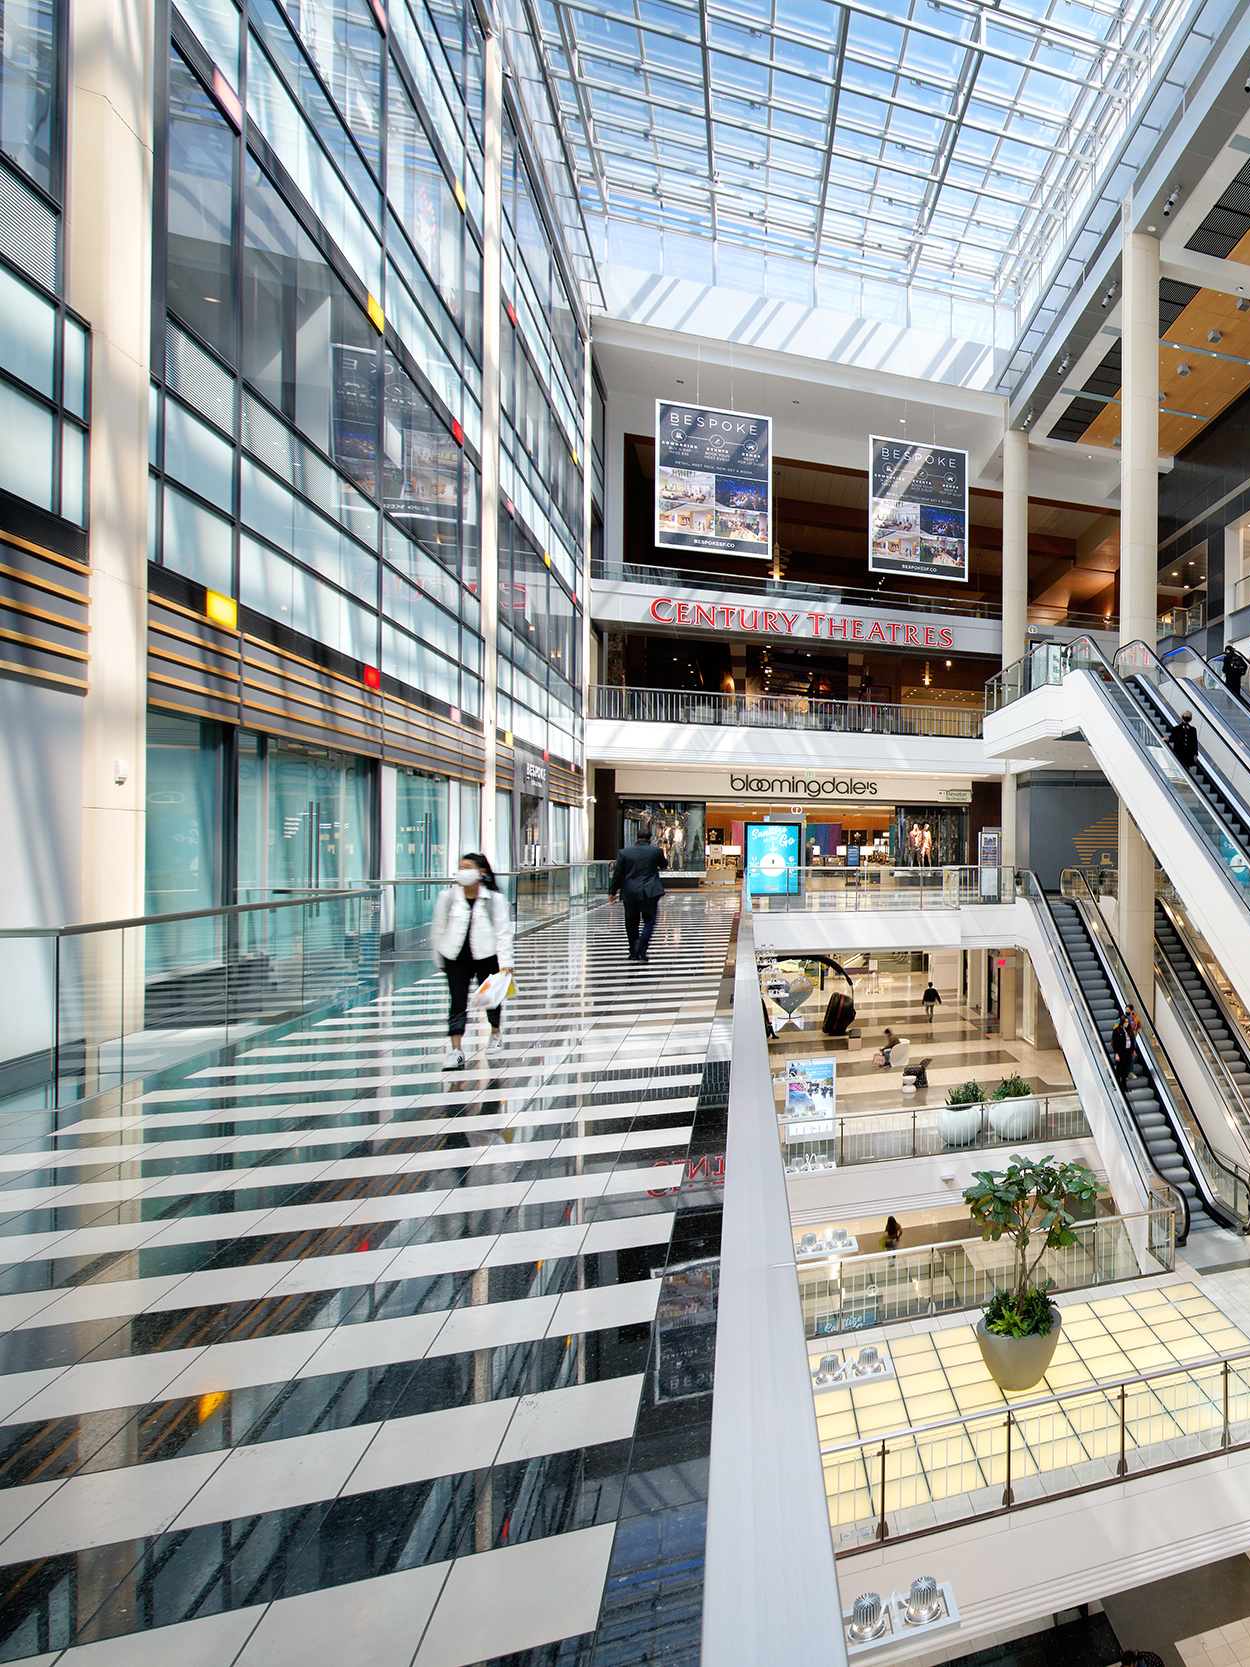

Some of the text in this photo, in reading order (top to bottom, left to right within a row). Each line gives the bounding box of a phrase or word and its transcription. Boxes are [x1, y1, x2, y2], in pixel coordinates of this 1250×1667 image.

[670, 412, 757, 436] BESPOKE
[881, 447, 956, 469] BESPOKE
[693, 539, 735, 549] BESPOKESF.CO
[649, 597, 955, 649] CENTURY THEATRES
[730, 773, 878, 797] bloomingdale's
[751, 825, 787, 840] Sanitize
[778, 834, 796, 847] Go
